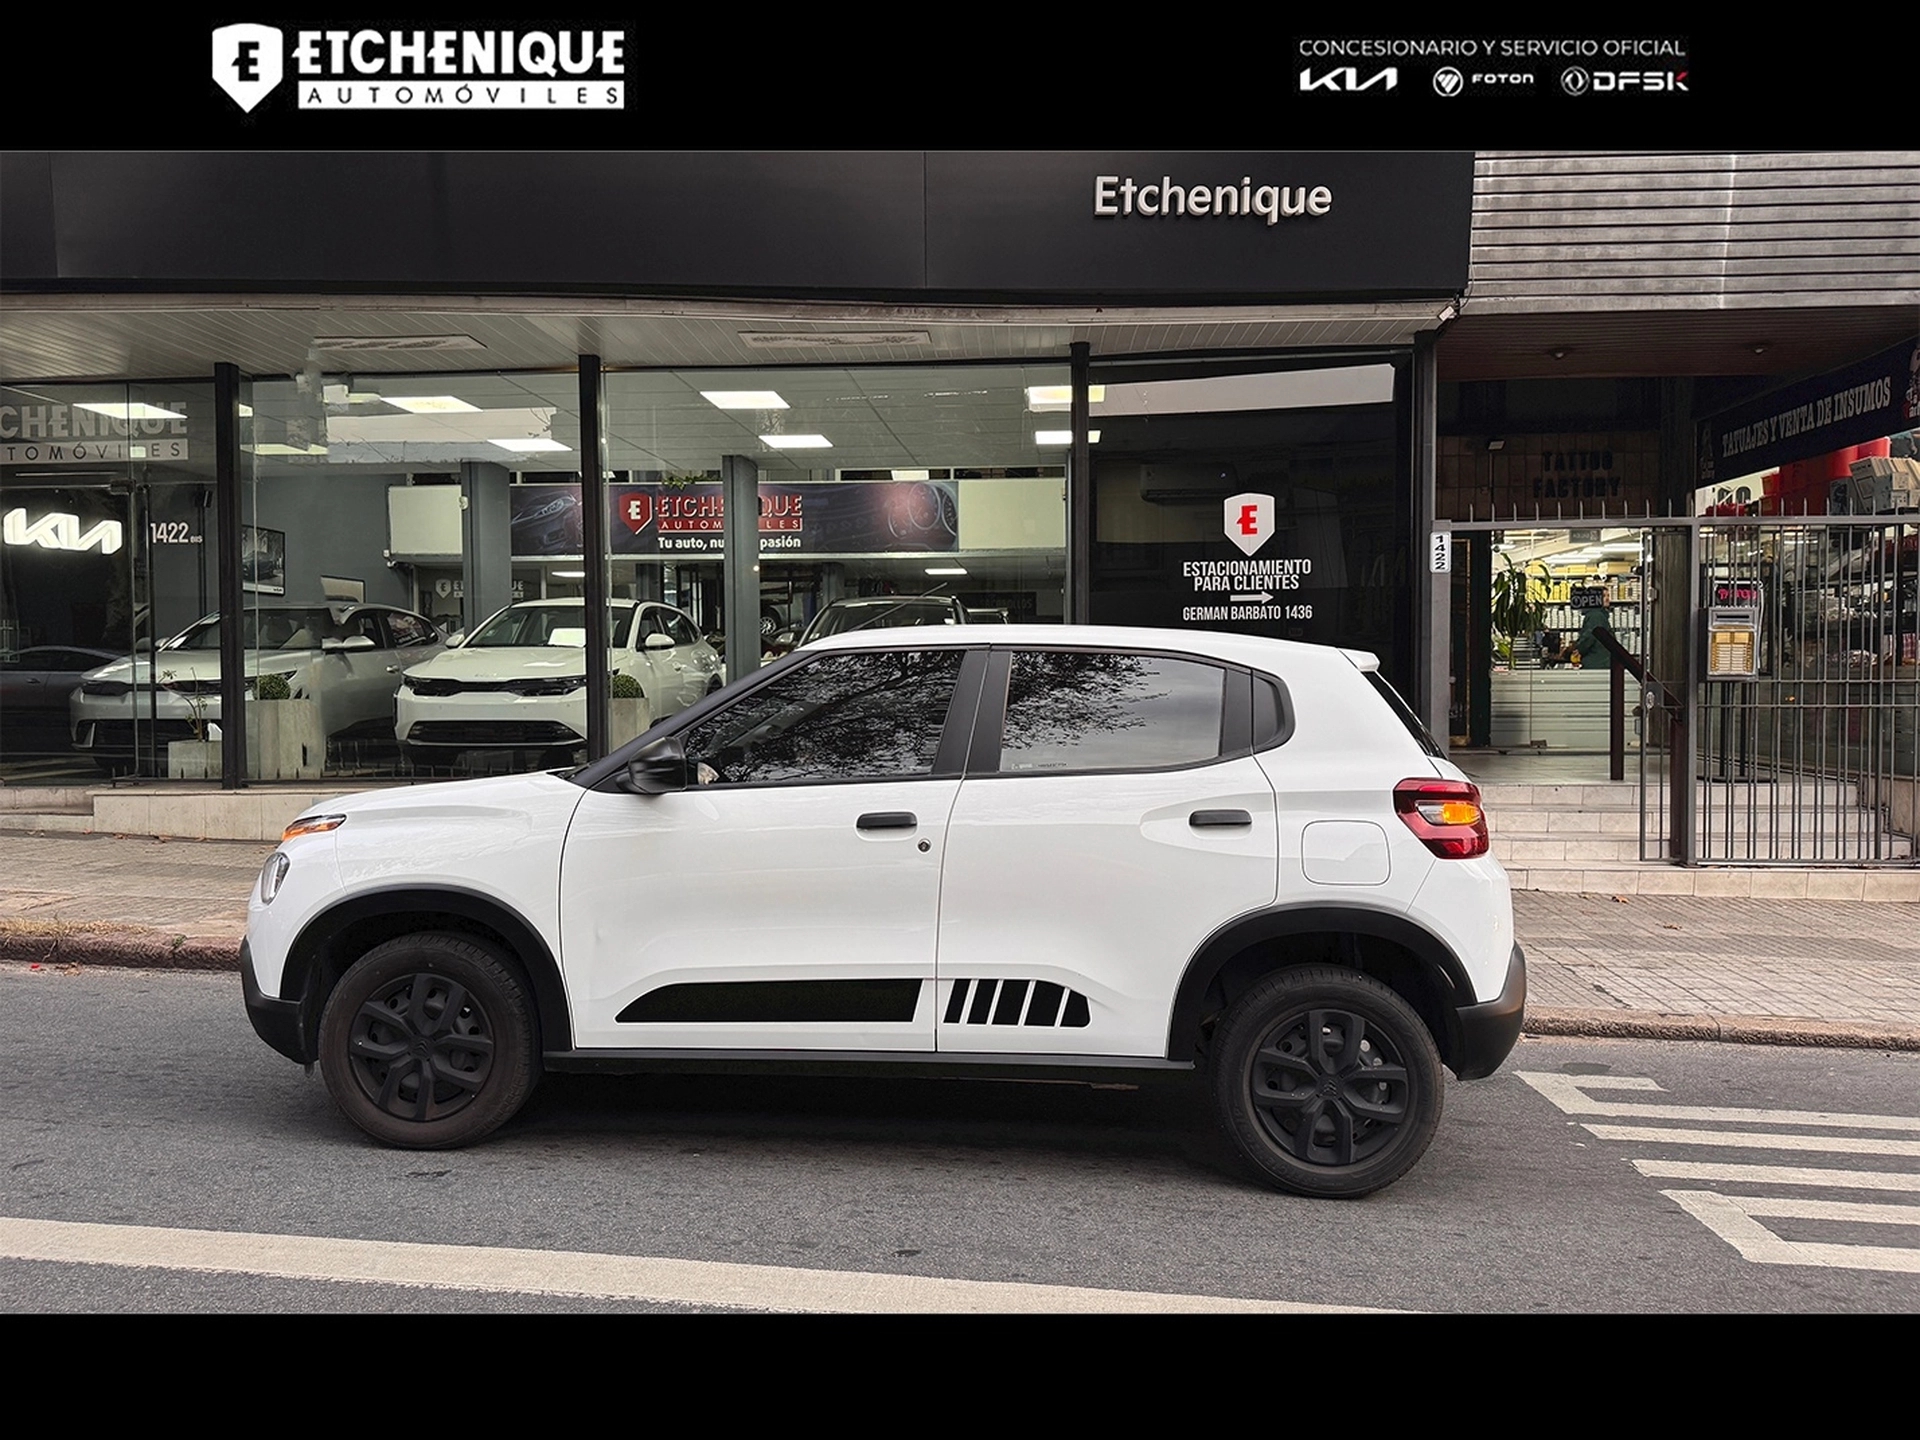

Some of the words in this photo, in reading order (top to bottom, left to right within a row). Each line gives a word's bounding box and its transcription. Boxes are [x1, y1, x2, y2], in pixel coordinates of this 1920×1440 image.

[1094, 175, 1332, 225] Etchenique
[1722, 418, 1769, 458] TATUAJES
[1769, 415, 1778, 443] Y
[1778, 402, 1815, 439] VENTA
[1816, 396, 1833, 427] DE
[1833, 375, 1891, 422] INSUMOS
[1542, 451, 1613, 472] TATTOO
[1533, 476, 1620, 498] FACTORY
[150, 522, 189, 544] 1422
[658, 537, 673, 549] Tu
[675, 538, 708, 551] auto,
[759, 535, 801, 550] pasión
[1434, 534, 1447, 571] 1422
[1183, 559, 1312, 577] ESTACIONAMIENTO
[1194, 576, 1230, 592] PARA
[1234, 574, 1300, 591] CLIENTES
[1182, 606, 1229, 621] GERMAN
[1231, 605, 1281, 620] BARBATO
[1285, 604, 1313, 619] 1436
